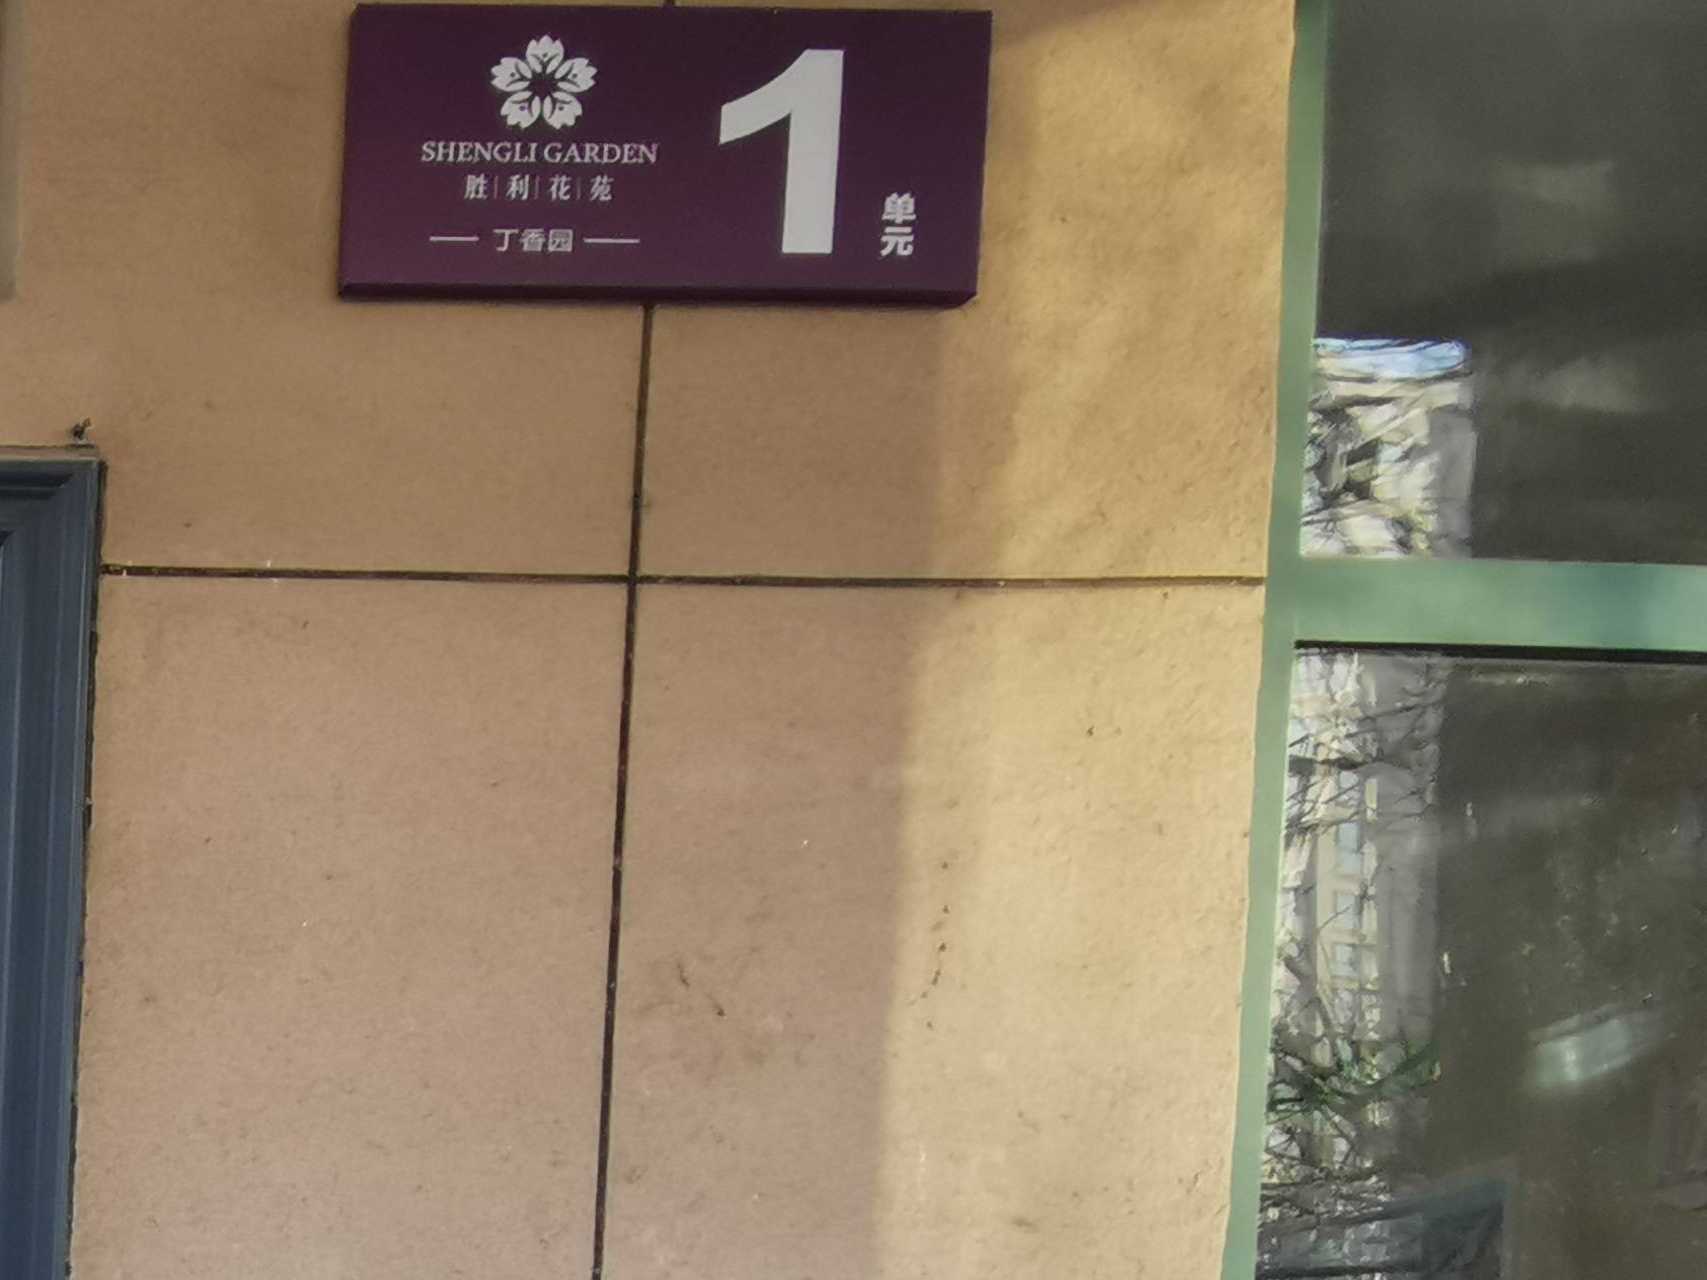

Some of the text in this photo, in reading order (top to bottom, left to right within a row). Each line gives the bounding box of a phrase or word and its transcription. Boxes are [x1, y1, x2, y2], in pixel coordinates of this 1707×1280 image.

[421, 140, 659, 165] SHENGLI GARDEN
[718, 48, 845, 254] 1
[463, 172, 614, 201] 胜利花苑
[879, 191, 917, 257] 单元
[493, 228, 573, 253] 丁香园
